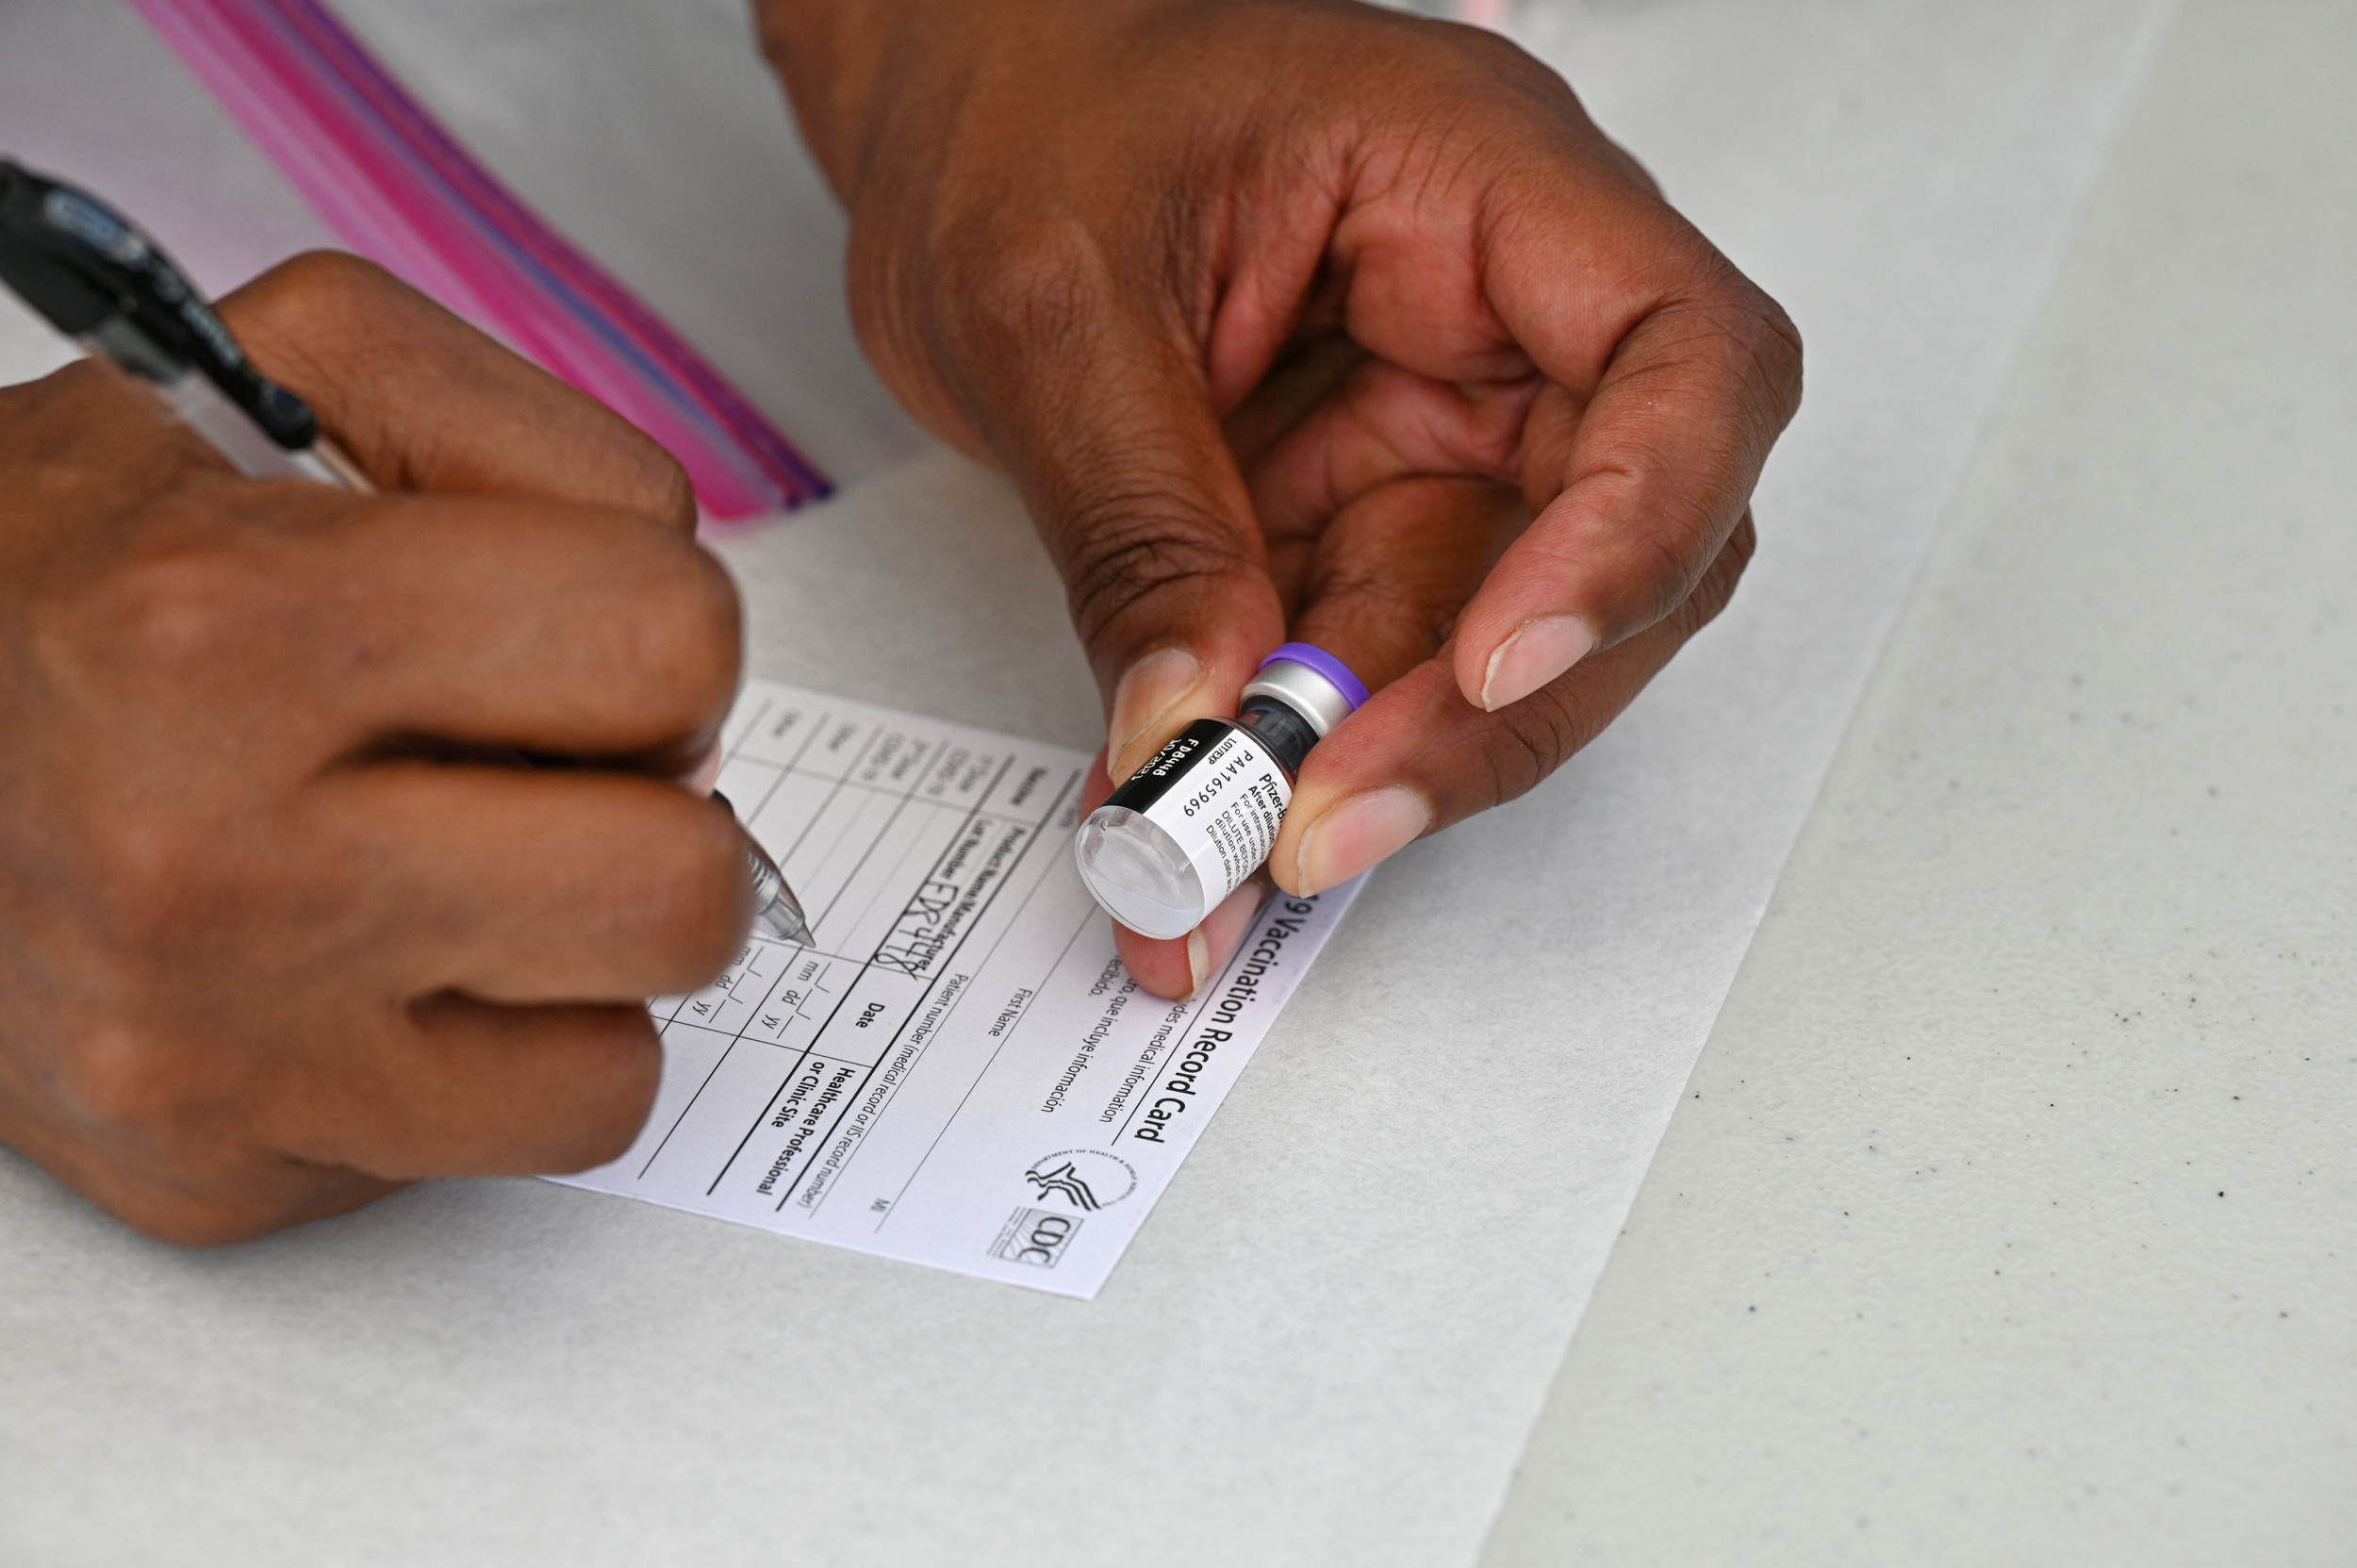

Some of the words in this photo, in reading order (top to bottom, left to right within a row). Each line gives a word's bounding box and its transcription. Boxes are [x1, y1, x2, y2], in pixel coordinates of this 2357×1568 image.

[1208, 737, 1237, 765] LOT/EXP
[1183, 750, 1254, 817] PAA165969
[1247, 784, 1267, 811] After
[1259, 772, 1289, 827] Pfizer-B
[1230, 801, 1244, 819] For
[1241, 816, 1252, 836] use
[1240, 793, 1253, 812] For
[1221, 810, 1244, 846] DILUTE
[1206, 824, 1228, 859] Dilution
[1224, 856, 1233, 879] date
[1214, 817, 1236, 850] dilution
[1233, 850, 1242, 875] when
[715, 974, 734, 990] dd
[798, 961, 818, 982] mm
[1211, 916, 1305, 1025] Vaccination
[782, 989, 800, 1006] dd
[935, 973, 969, 1007] Patient
[1003, 987, 1033, 1013] First
[1106, 996, 1128, 1016] que
[692, 1000, 712, 1016] yy
[762, 1015, 781, 1030] yy
[855, 1002, 885, 1029] Date
[988, 1011, 1016, 1037] Name
[911, 1006, 942, 1047] number
[1081, 1015, 1118, 1052] incluye
[1139, 1024, 1173, 1065] medical
[809, 1062, 825, 1076] or
[882, 1044, 919, 1086] (medical
[1165, 1027, 1233, 1097] Record
[786, 1074, 819, 1107] Clinic
[803, 1067, 856, 1127] Healthcare
[864, 1084, 888, 1115] record
[1041, 1052, 1094, 1114] información
[1099, 1064, 1150, 1123] information
[771, 1105, 799, 1129] Site
[847, 1123, 865, 1138] IIS
[857, 1114, 869, 1127] or
[1134, 1098, 1186, 1144] Card
[756, 1127, 815, 1196] Professional
[827, 1137, 852, 1170] record
[796, 1165, 832, 1209] number)
[1017, 1216, 1072, 1263] CDC
